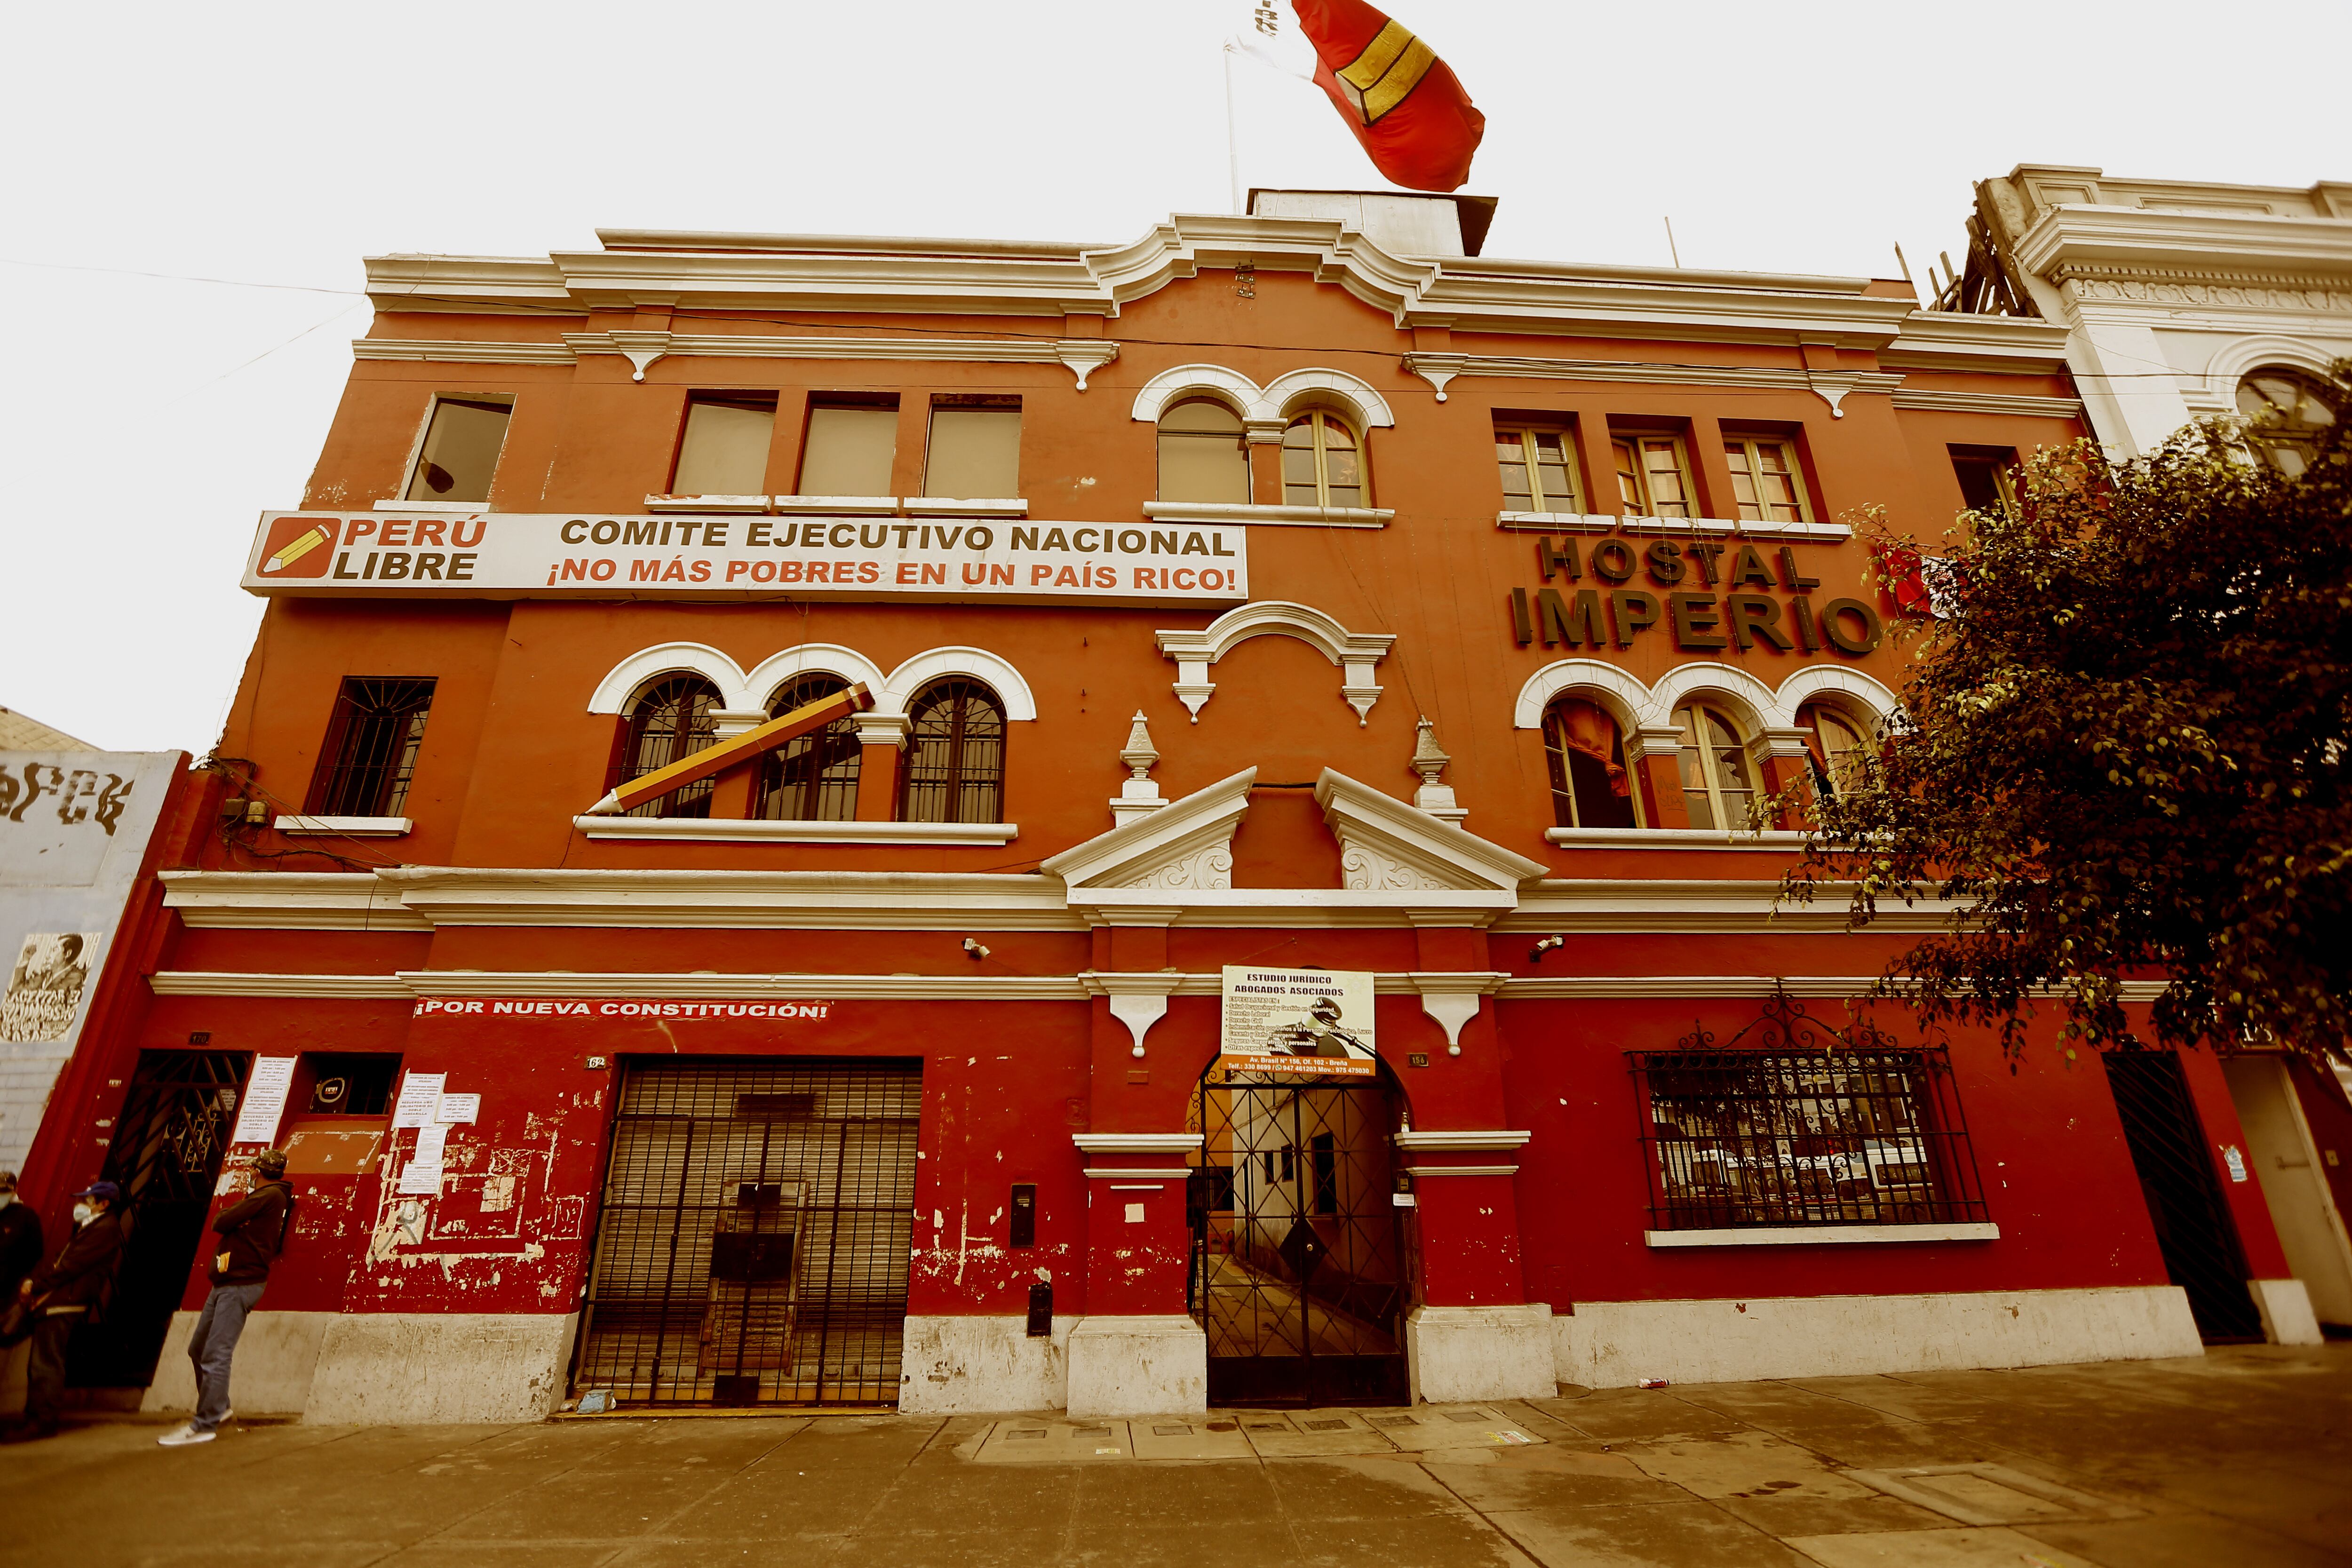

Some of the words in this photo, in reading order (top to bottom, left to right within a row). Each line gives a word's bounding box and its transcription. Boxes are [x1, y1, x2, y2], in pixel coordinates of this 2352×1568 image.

[342, 514, 487, 548] PERÚ
[560, 520, 729, 547] COMITE
[746, 522, 993, 550] EJECUTIVO
[1011, 526, 1237, 557] NACIONAL
[332, 552, 479, 581] LIBRE
[546, 558, 617, 586] ¡NO
[629, 555, 712, 583] MÁS
[725, 559, 880, 584] POBRES
[896, 562, 947, 585] EN
[961, 563, 1015, 586] UN
[1030, 560, 1117, 588] PAÍS
[1133, 567, 1236, 591] RICO!
[1539, 536, 1820, 588] HOSTAL
[1510, 587, 1882, 653] IMPERIO
[1235, 985, 1286, 994] ABOGADOS
[1290, 987, 1344, 996] ASOCIADOS
[1247, 974, 1287, 982] ESTUDIO
[1288, 975, 1332, 984] JURÍDICO
[415, 1001, 484, 1016] ¡POR
[493, 1002, 591, 1014] NUEVA
[600, 1003, 827, 1018] CONSTITUCIÓN!
[587, 1059, 604, 1067] 162
